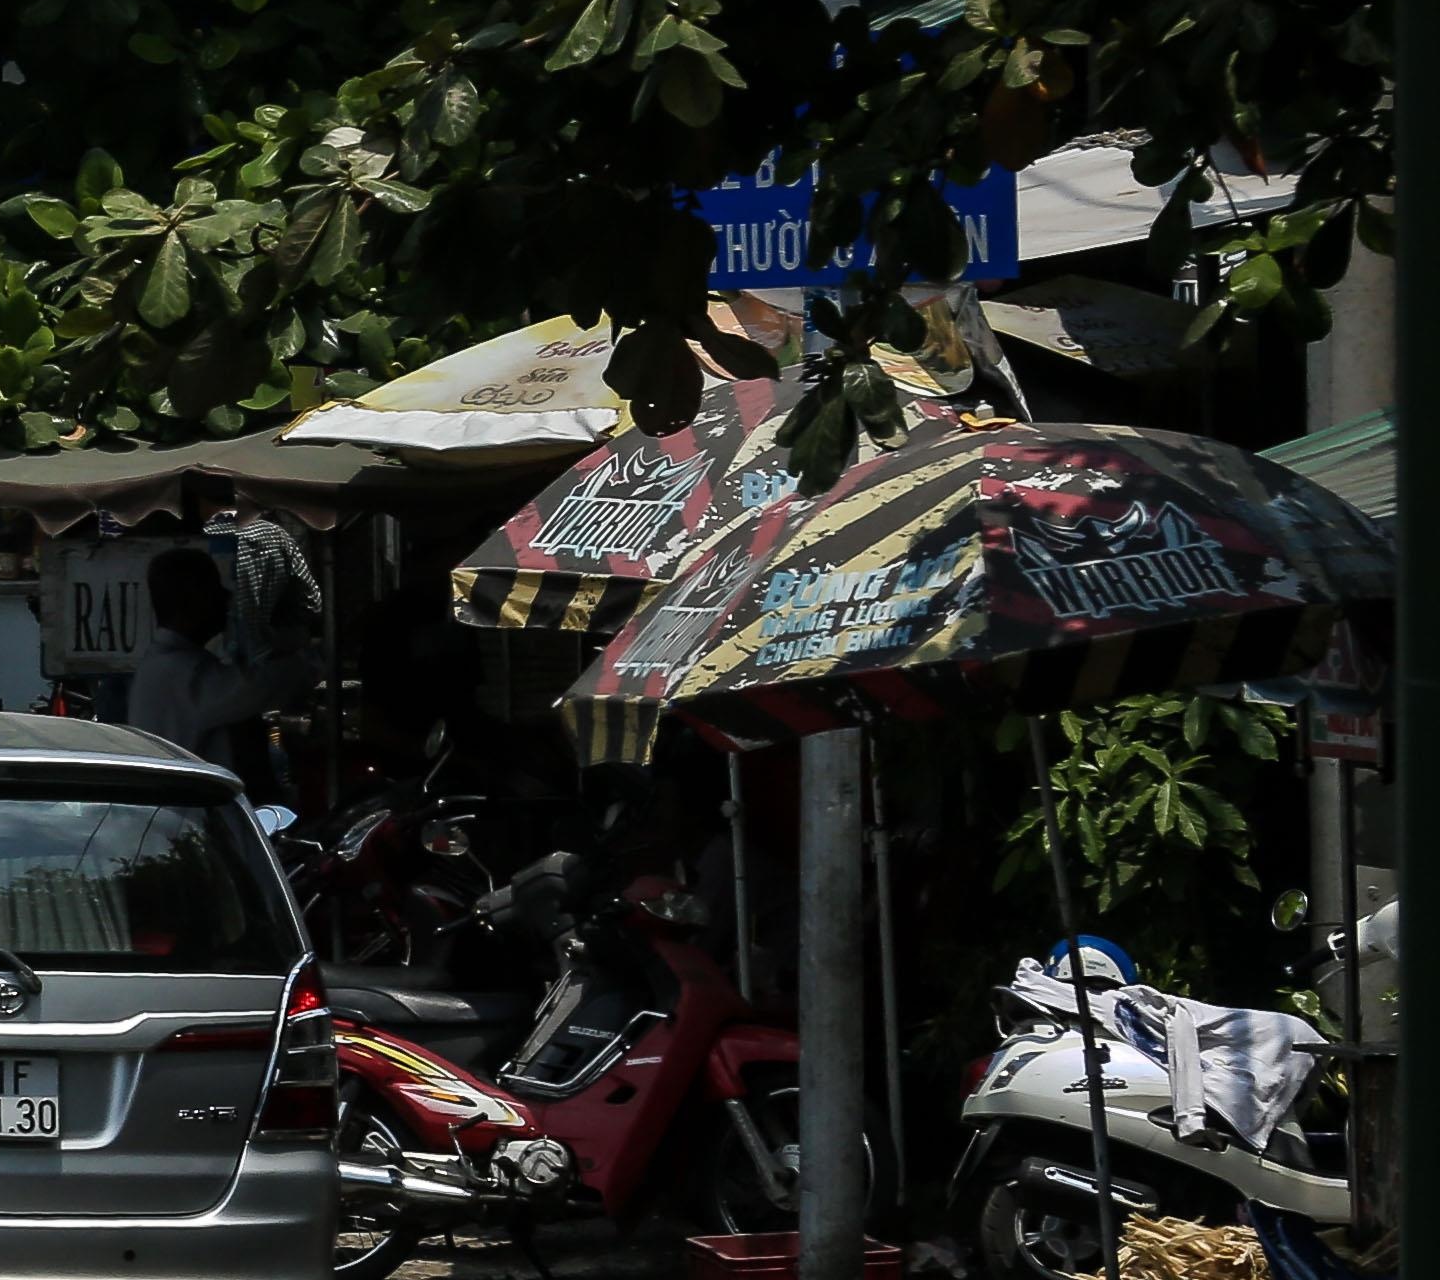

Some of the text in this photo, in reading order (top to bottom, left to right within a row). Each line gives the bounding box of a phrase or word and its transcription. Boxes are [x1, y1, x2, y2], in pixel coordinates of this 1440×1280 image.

[1025, 540, 1248, 618] WARRIOR
[73, 581, 140, 654] RAU
[569, 1025, 618, 1039] SUZUKI
